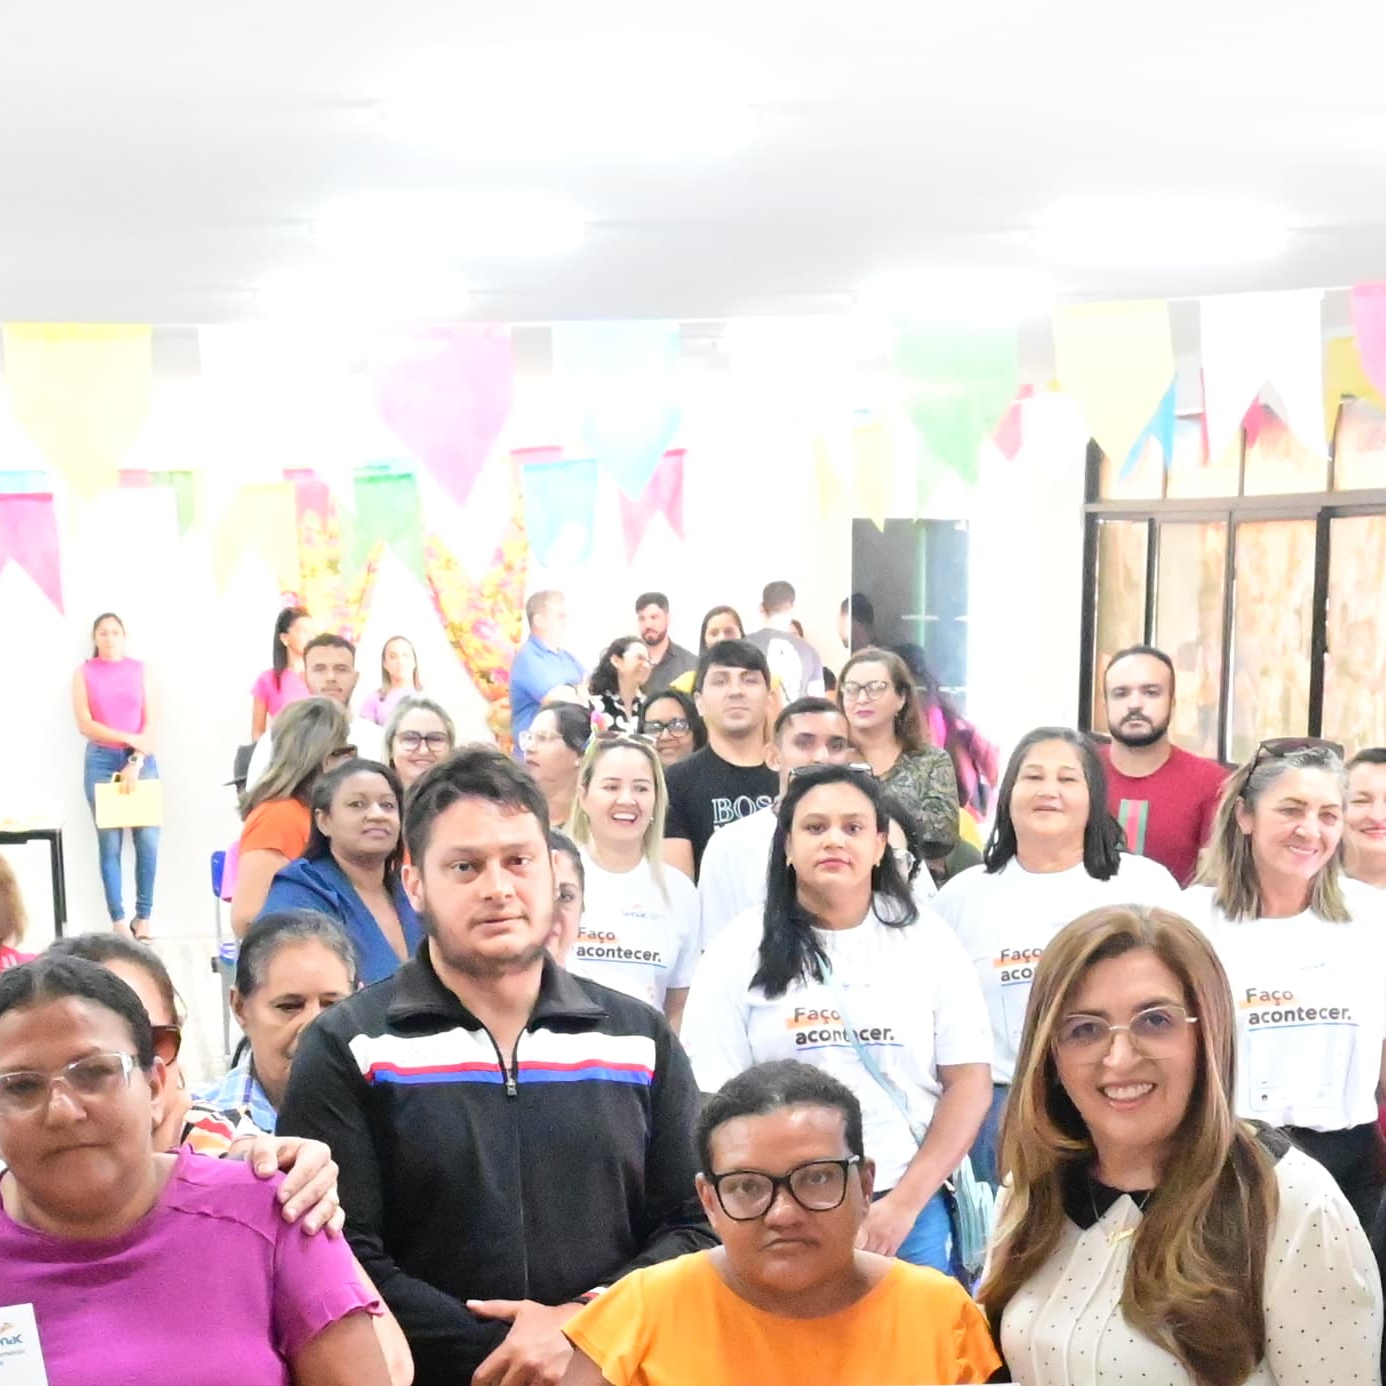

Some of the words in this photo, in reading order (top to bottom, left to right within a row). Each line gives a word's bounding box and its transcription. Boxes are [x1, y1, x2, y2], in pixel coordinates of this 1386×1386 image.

[577, 927, 616, 944] Faço
[576, 946, 662, 962] acontecer.
[1001, 948, 1044, 963] Faço
[1246, 988, 1294, 1006] Faço
[794, 1007, 841, 1025] Faço
[1248, 1007, 1352, 1025] acontecer.
